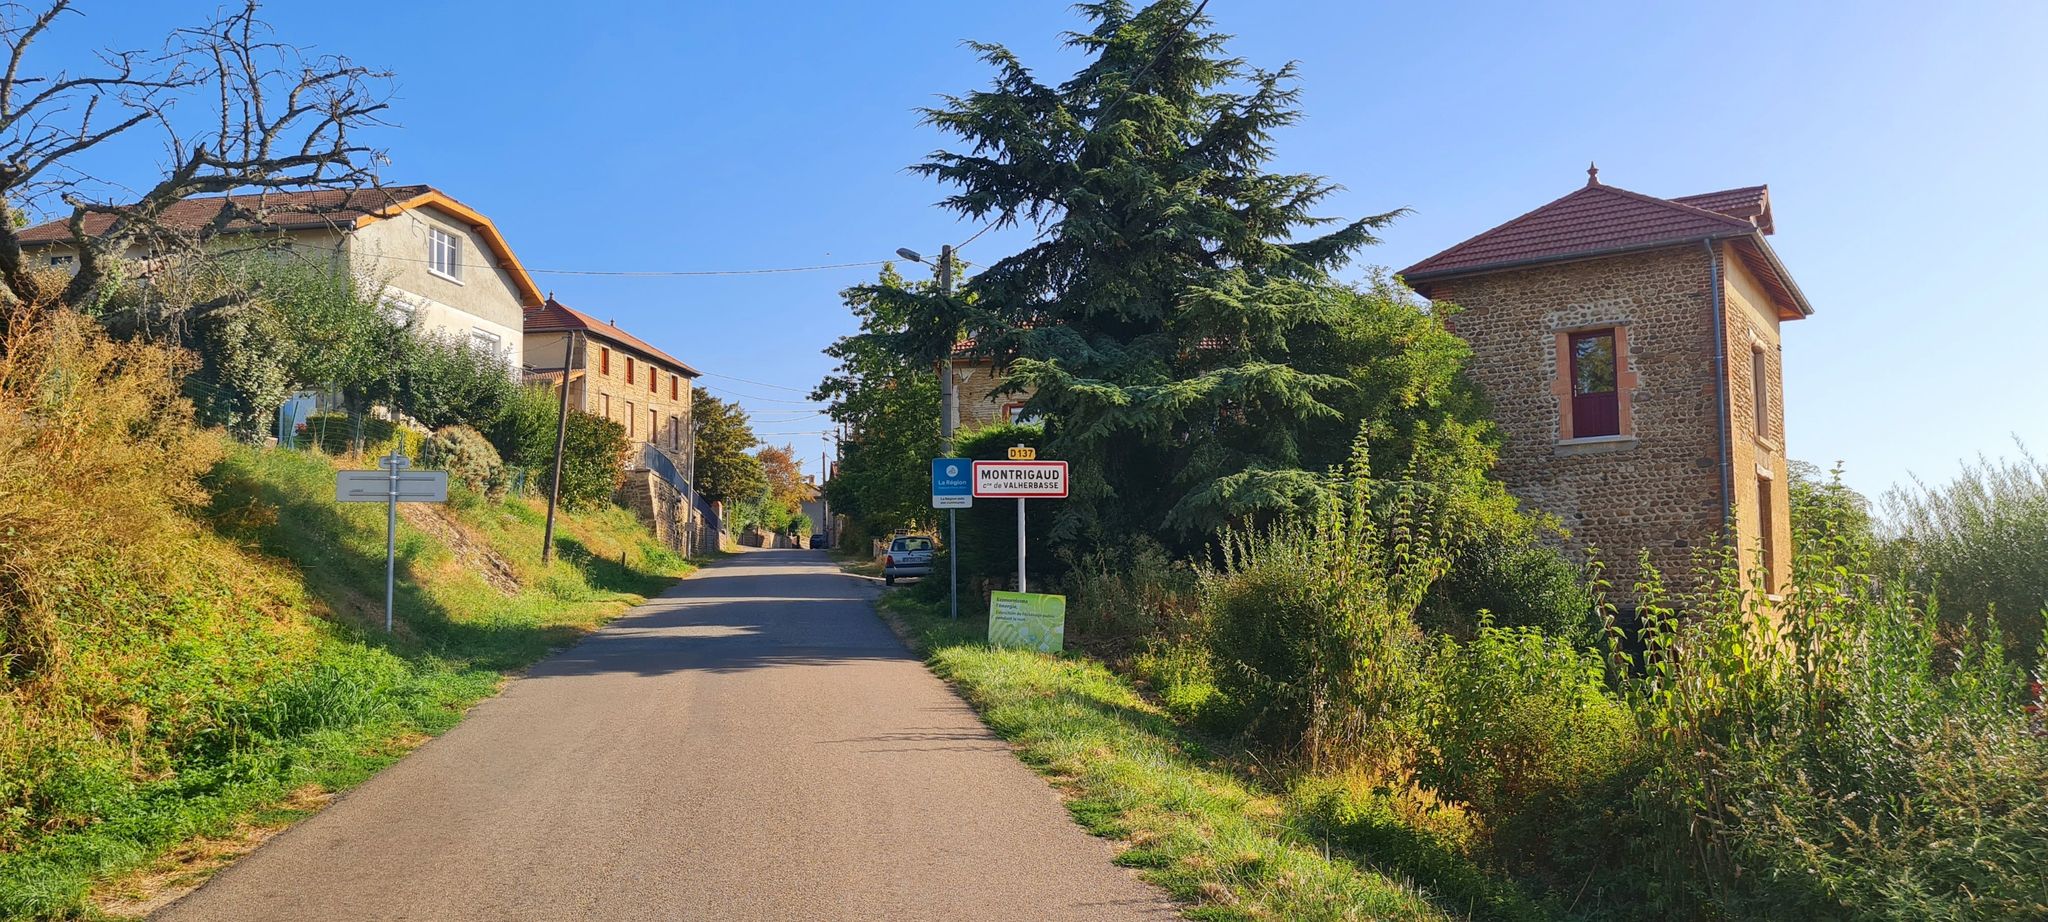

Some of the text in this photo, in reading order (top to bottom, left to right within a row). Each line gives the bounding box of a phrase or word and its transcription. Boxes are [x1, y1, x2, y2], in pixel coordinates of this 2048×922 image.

[1010, 449, 1033, 458] D 137
[981, 469, 1060, 480] MONTRIGAUD
[993, 481, 1002, 489] de
